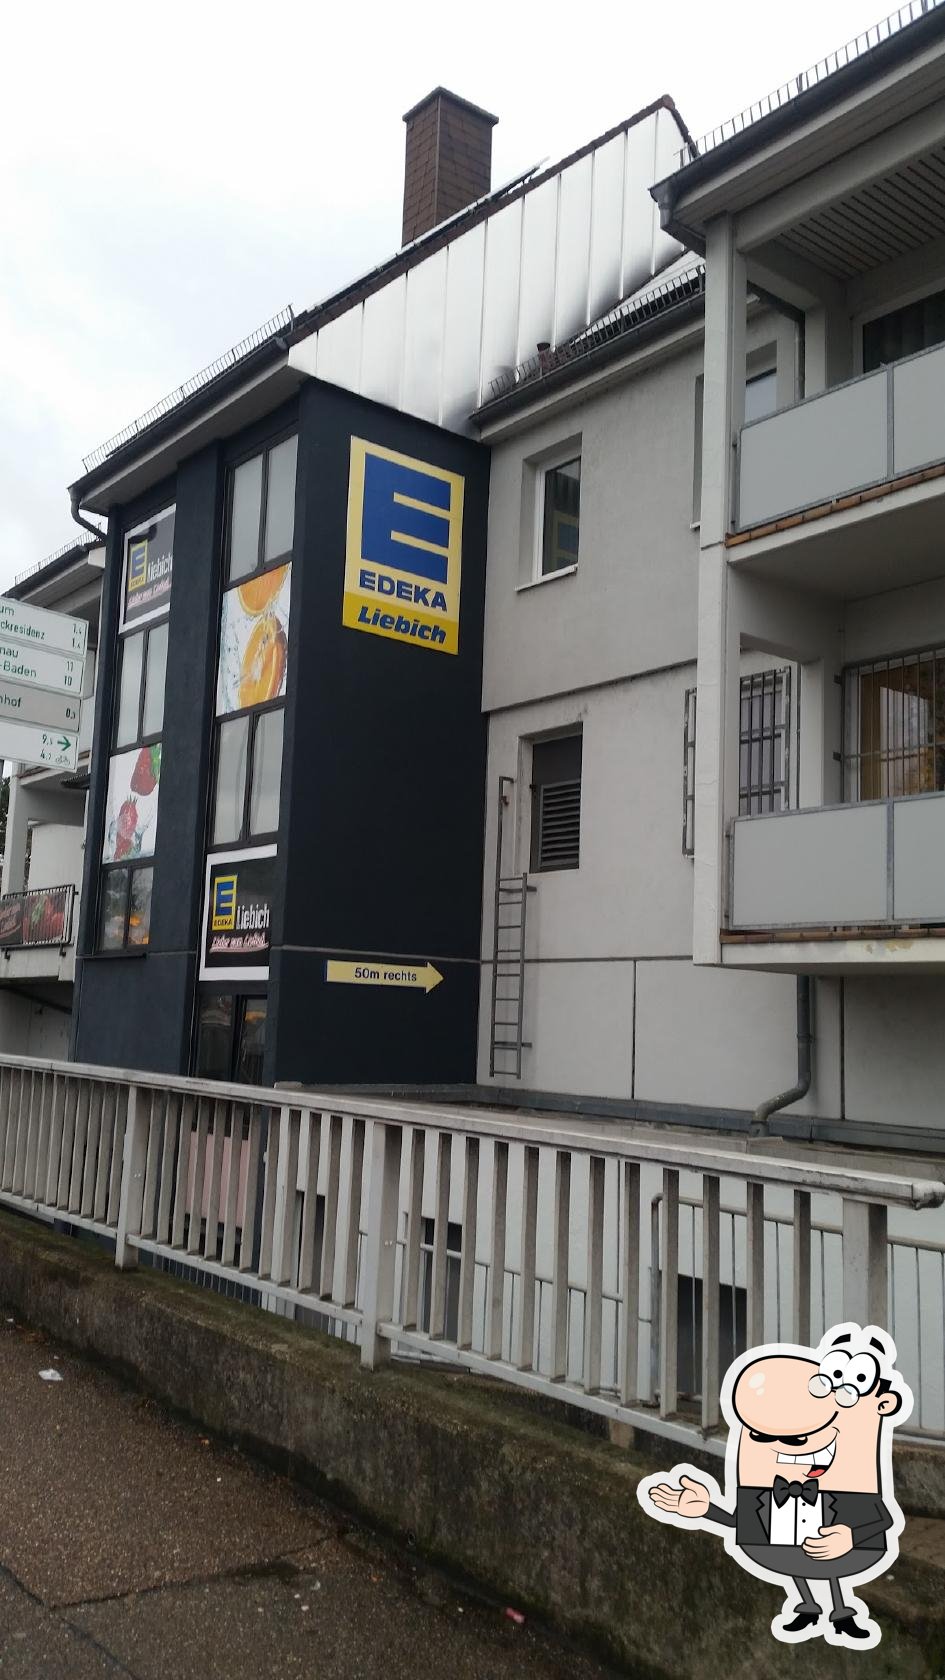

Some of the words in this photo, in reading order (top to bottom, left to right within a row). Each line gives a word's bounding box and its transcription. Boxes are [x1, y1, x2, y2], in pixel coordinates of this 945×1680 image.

[361, 452, 451, 585] E
[359, 569, 448, 612] EDEKA
[357, 605, 447, 644] Liebich
[236, 903, 270, 930] Liebich
[355, 967, 379, 979] 50m
[383, 970, 417, 981] rechts
